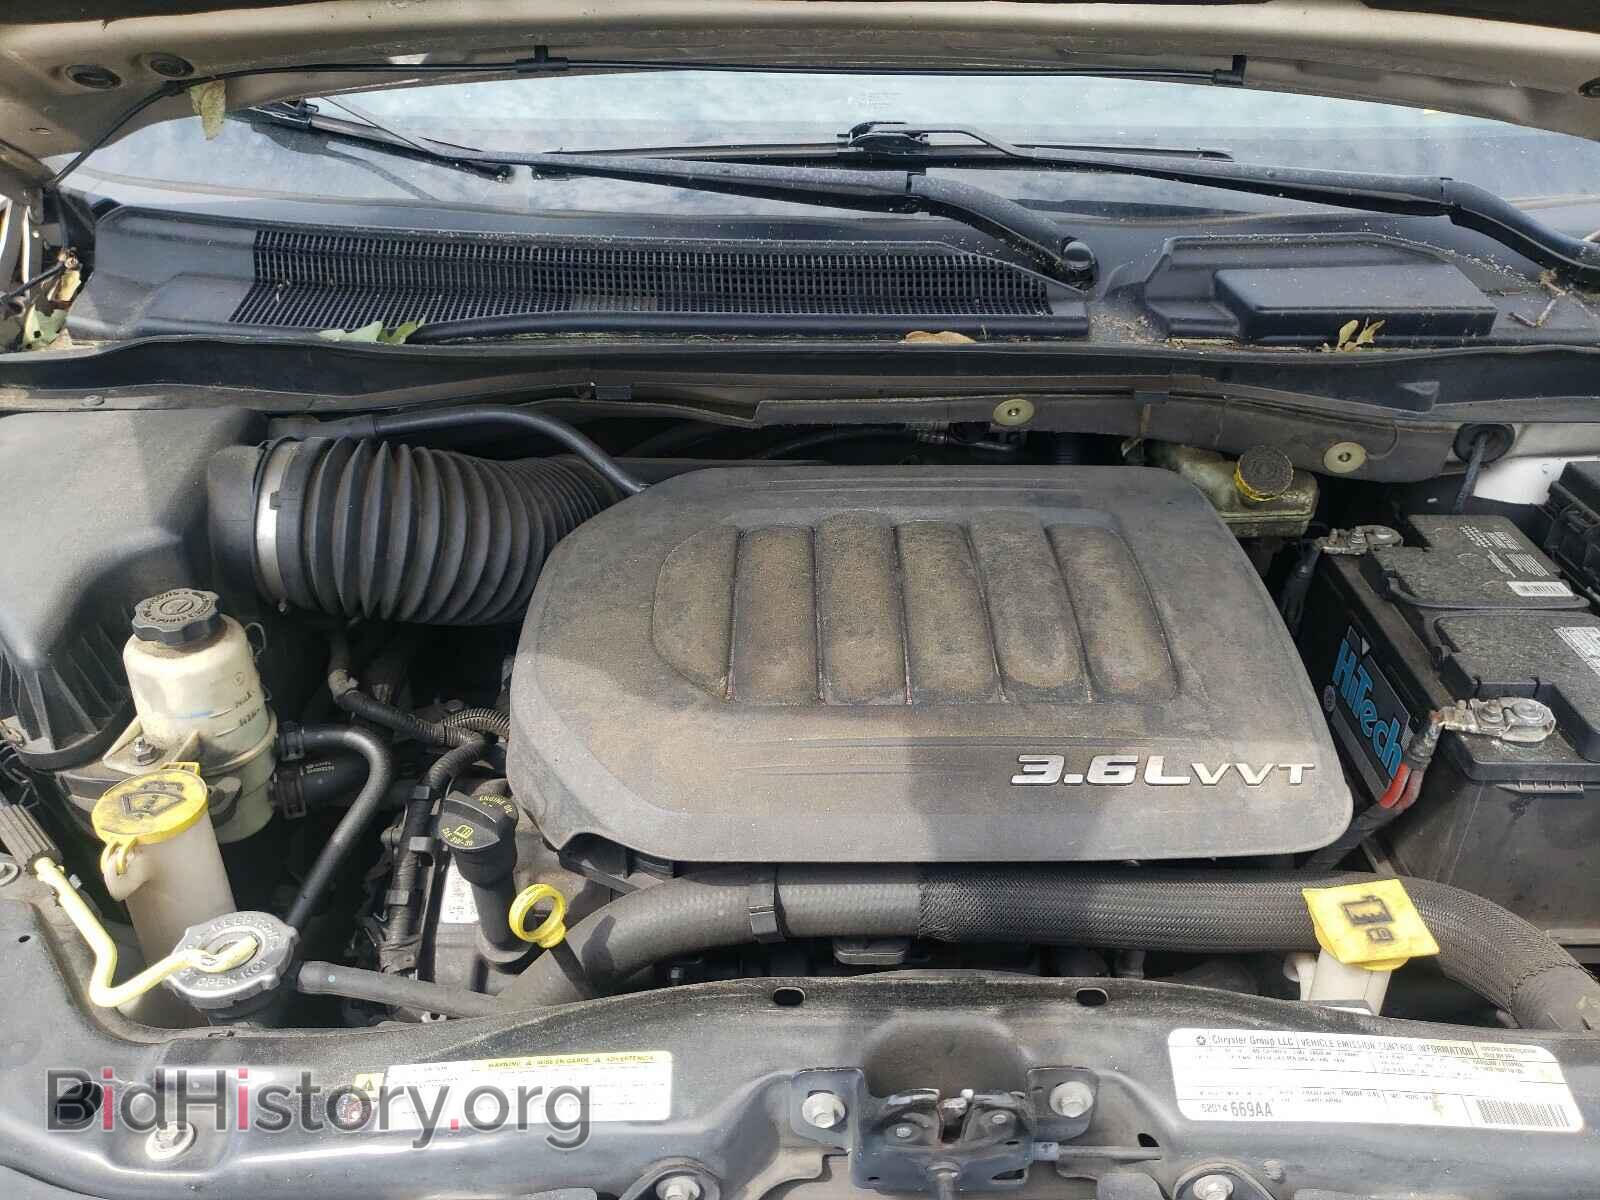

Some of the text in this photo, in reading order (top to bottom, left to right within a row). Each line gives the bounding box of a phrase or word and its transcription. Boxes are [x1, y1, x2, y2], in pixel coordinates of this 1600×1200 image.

[1332, 638, 1403, 779] HiTech
[1010, 754, 1315, 785] 3.6L VVT
[1212, 1034, 1294, 1047] Chrysler Group LLC
[1301, 1038, 1334, 1048] VEHICLE
[1336, 1039, 1375, 1049] EMISSION
[1417, 1043, 1474, 1056] INFORMATION
[1231, 1101, 1273, 1117] 669AA
